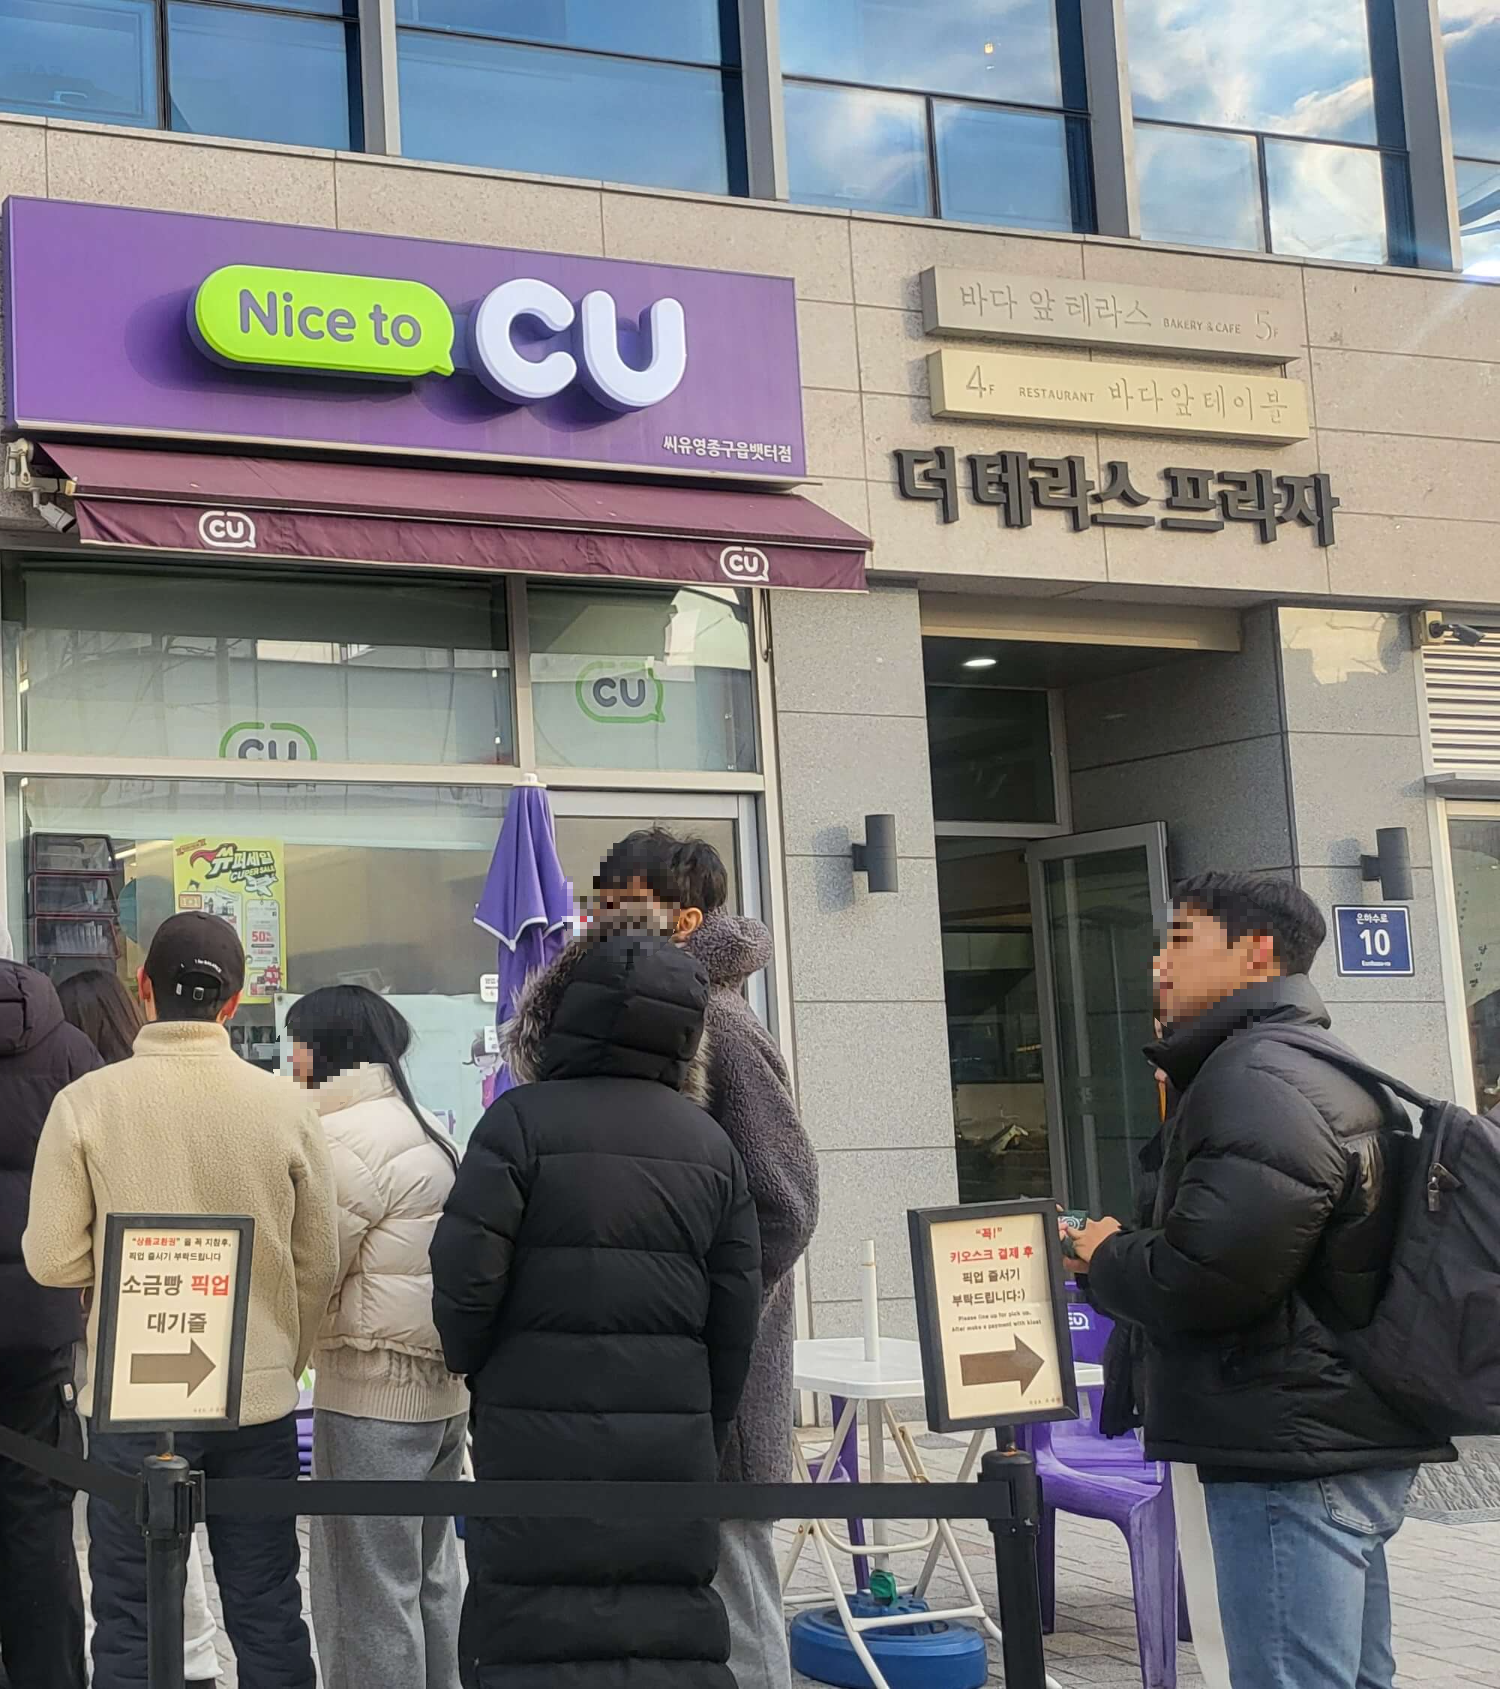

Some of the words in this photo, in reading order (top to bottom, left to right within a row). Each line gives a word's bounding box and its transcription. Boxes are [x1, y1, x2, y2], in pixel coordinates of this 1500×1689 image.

[960, 282, 1018, 319] 바다
[1029, 288, 1056, 321] 앞
[1163, 317, 1202, 331] BAKERY
[1215, 322, 1242, 334] CAFE
[238, 288, 356, 343] Nice
[368, 303, 422, 347] to
[475, 277, 687, 409] CU
[1019, 386, 1095, 403] RESTAURANT
[663, 435, 792, 463] 씨유영종구읍뱃터점
[209, 519, 245, 539] CU
[729, 554, 759, 573] CU
[593, 677, 646, 708] CU
[1356, 912, 1389, 925] 은하수로
[1359, 928, 1391, 956] 10
[950, 1249, 994, 1264] 키오스크
[998, 1246, 1019, 1260] 결제
[1022, 1245, 1034, 1259] 후
[121, 1274, 183, 1296] 소금빵
[191, 1274, 230, 1296] 픽업
[962, 1270, 984, 1284] 픽업
[988, 1267, 1020, 1283] 줄서기
[147, 1311, 208, 1334] 대기줄
